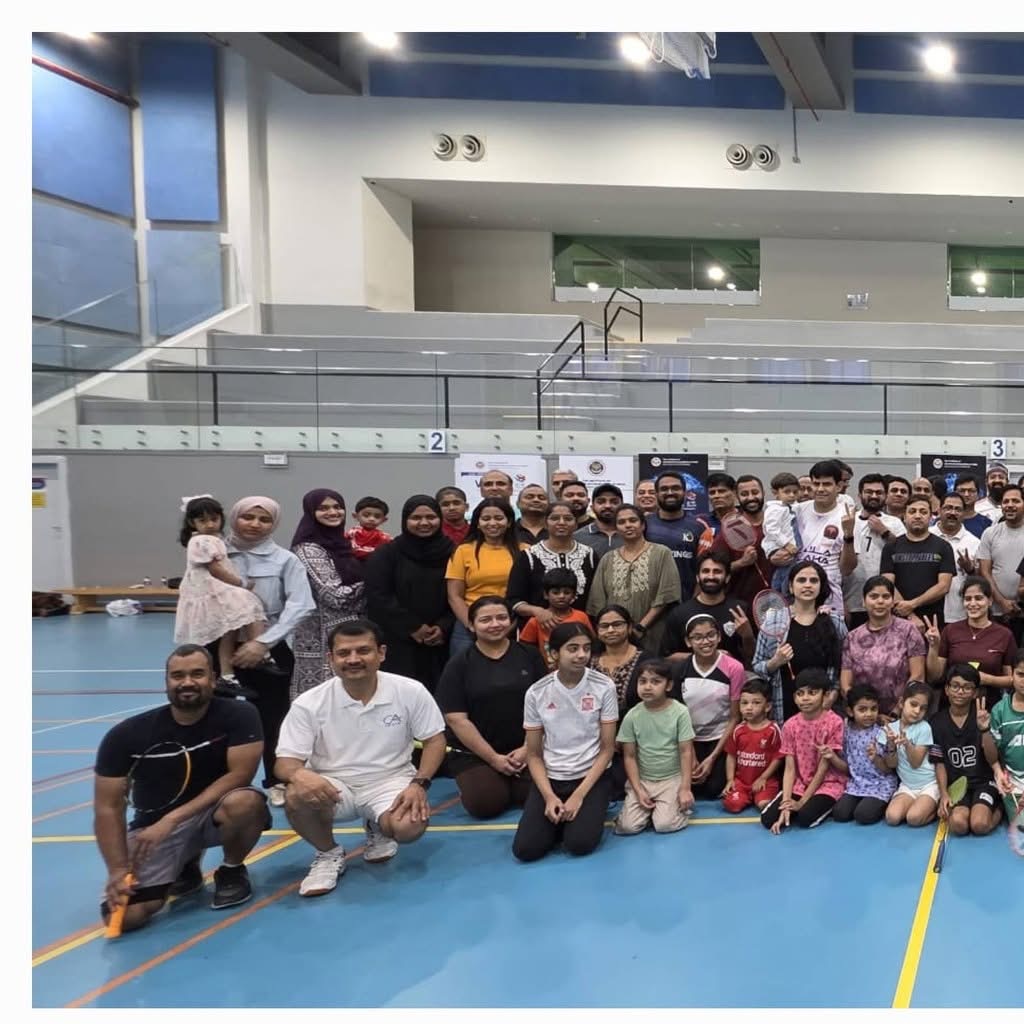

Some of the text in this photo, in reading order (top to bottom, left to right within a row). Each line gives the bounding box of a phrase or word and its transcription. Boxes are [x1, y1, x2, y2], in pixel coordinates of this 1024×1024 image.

[431, 432, 443, 451] 2
[993, 439, 1004, 457] 3
[948, 745, 977, 768] 02
